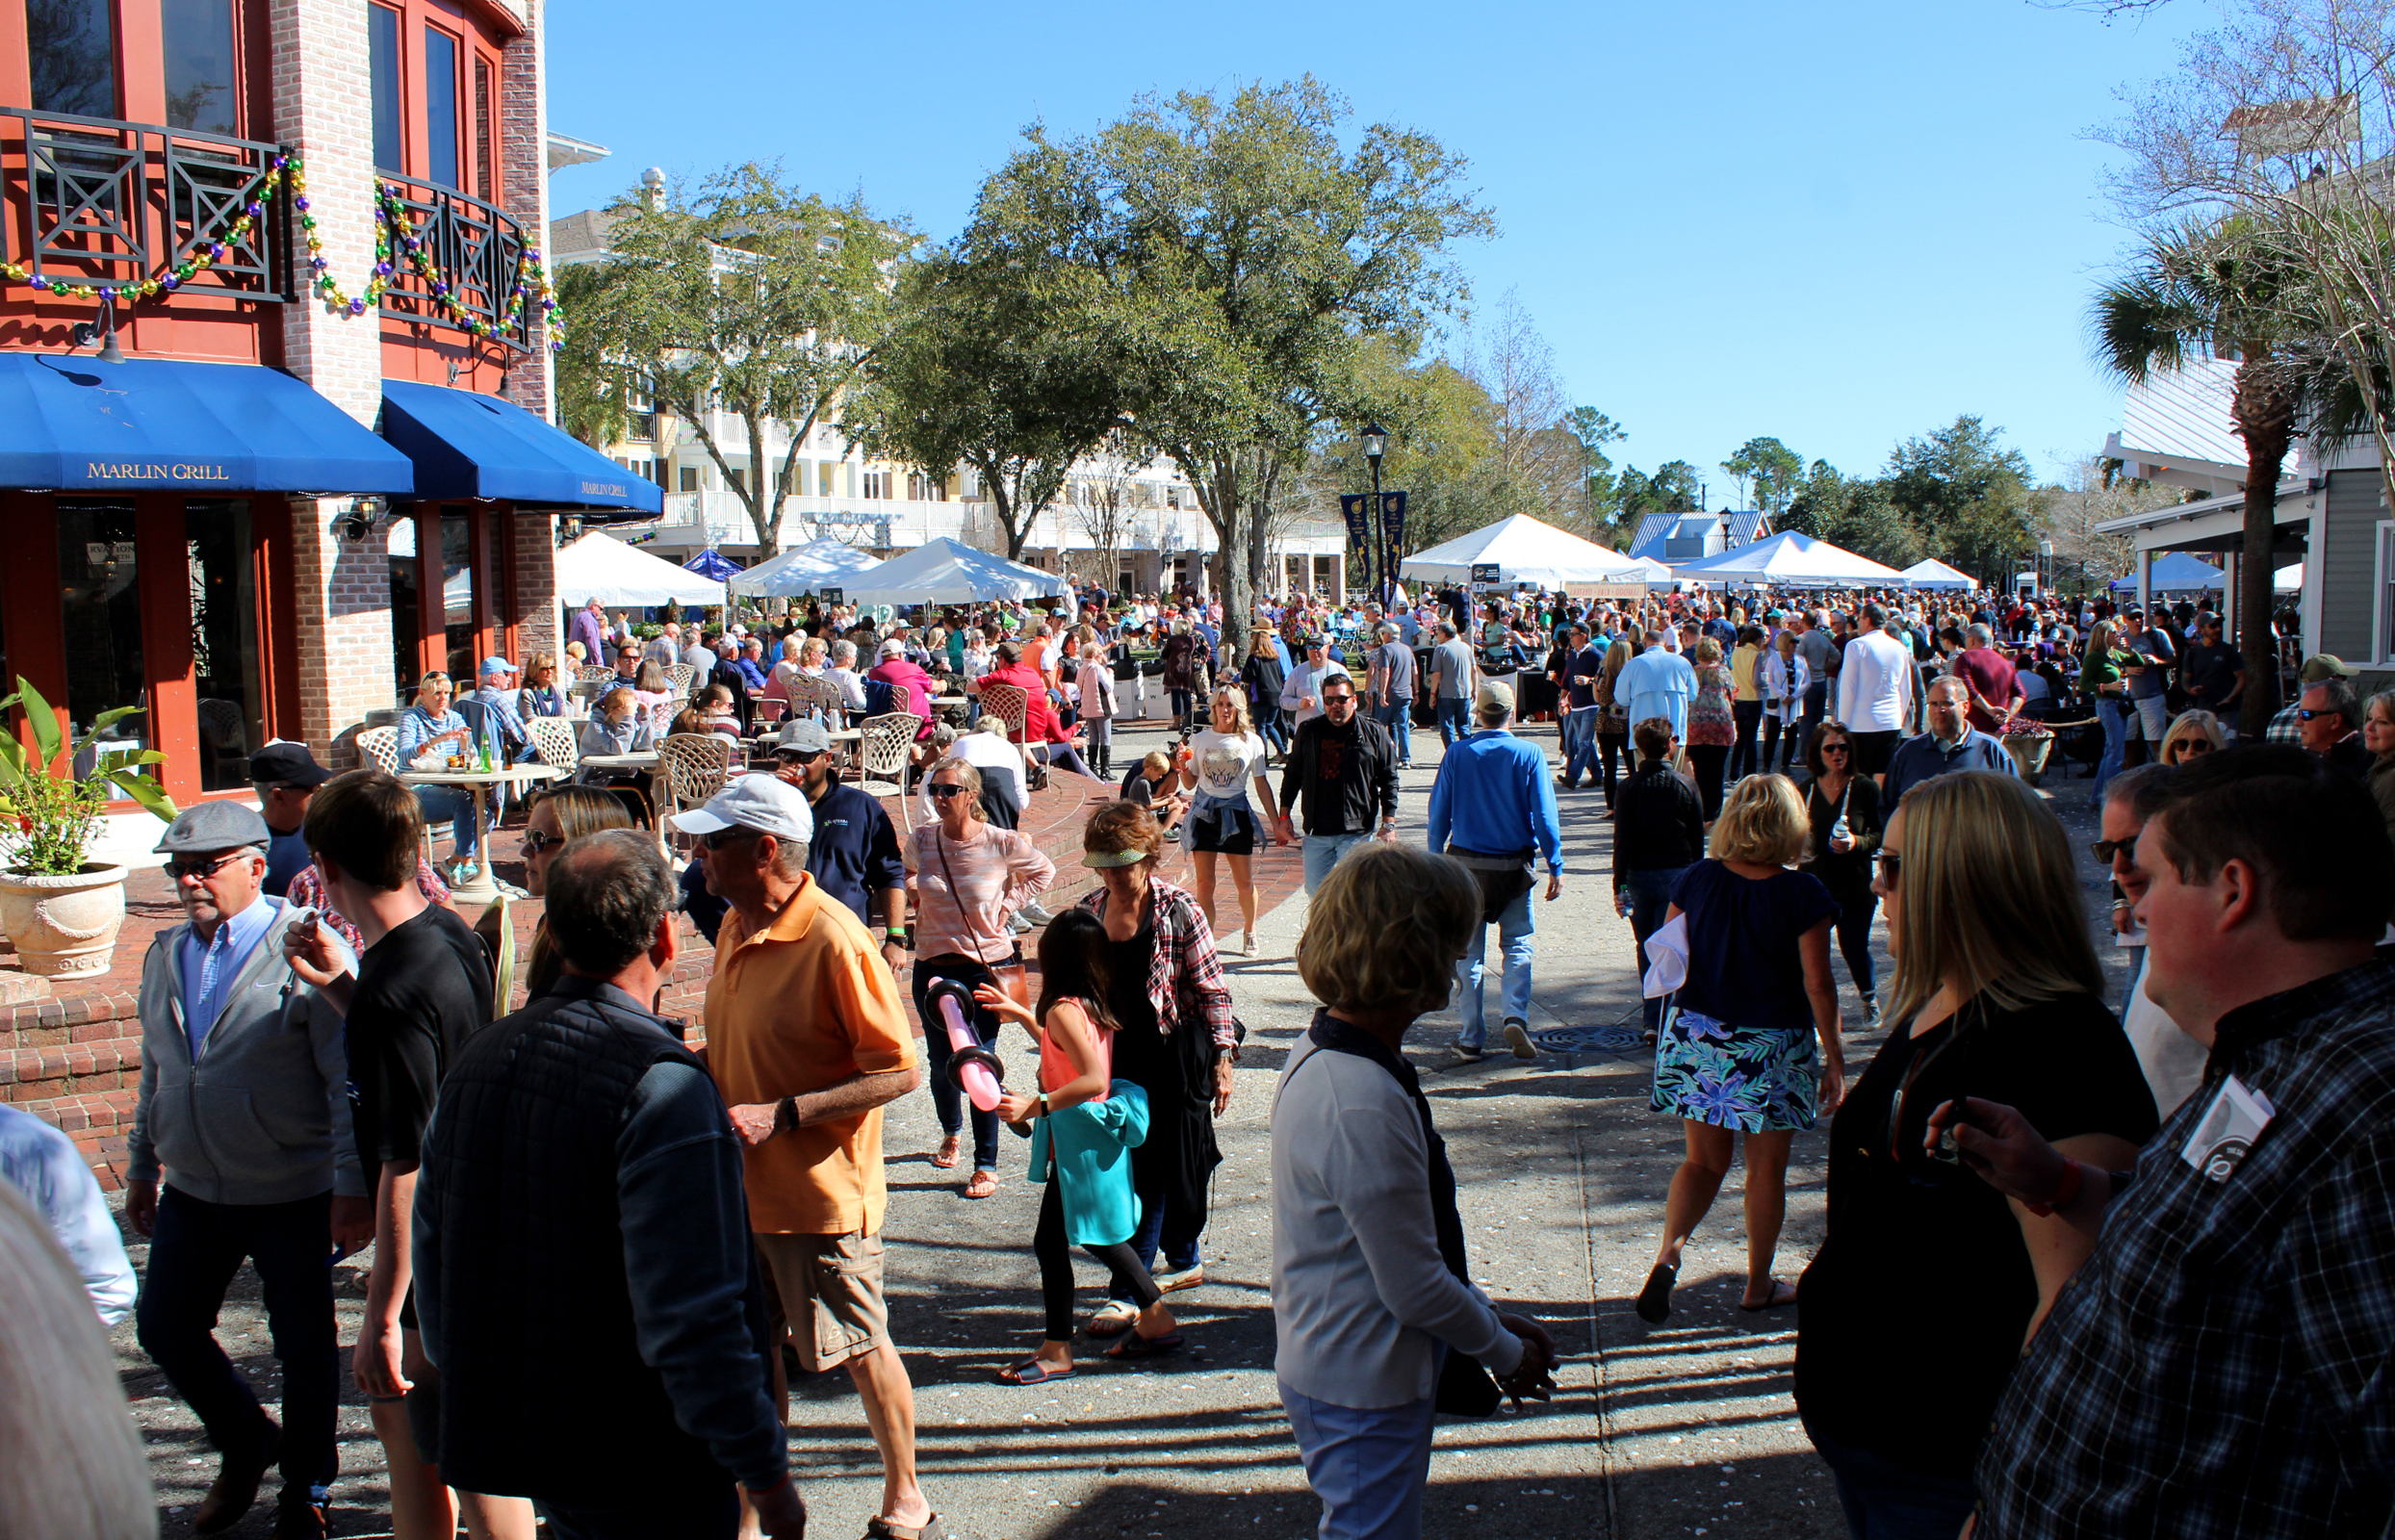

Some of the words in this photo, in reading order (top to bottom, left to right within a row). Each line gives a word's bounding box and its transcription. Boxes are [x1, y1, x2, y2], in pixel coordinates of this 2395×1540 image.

[87, 462, 168, 479] MARLIN
[171, 463, 229, 480] GRILL
[581, 481, 607, 495] MARLIN
[608, 483, 628, 497] GRILL
